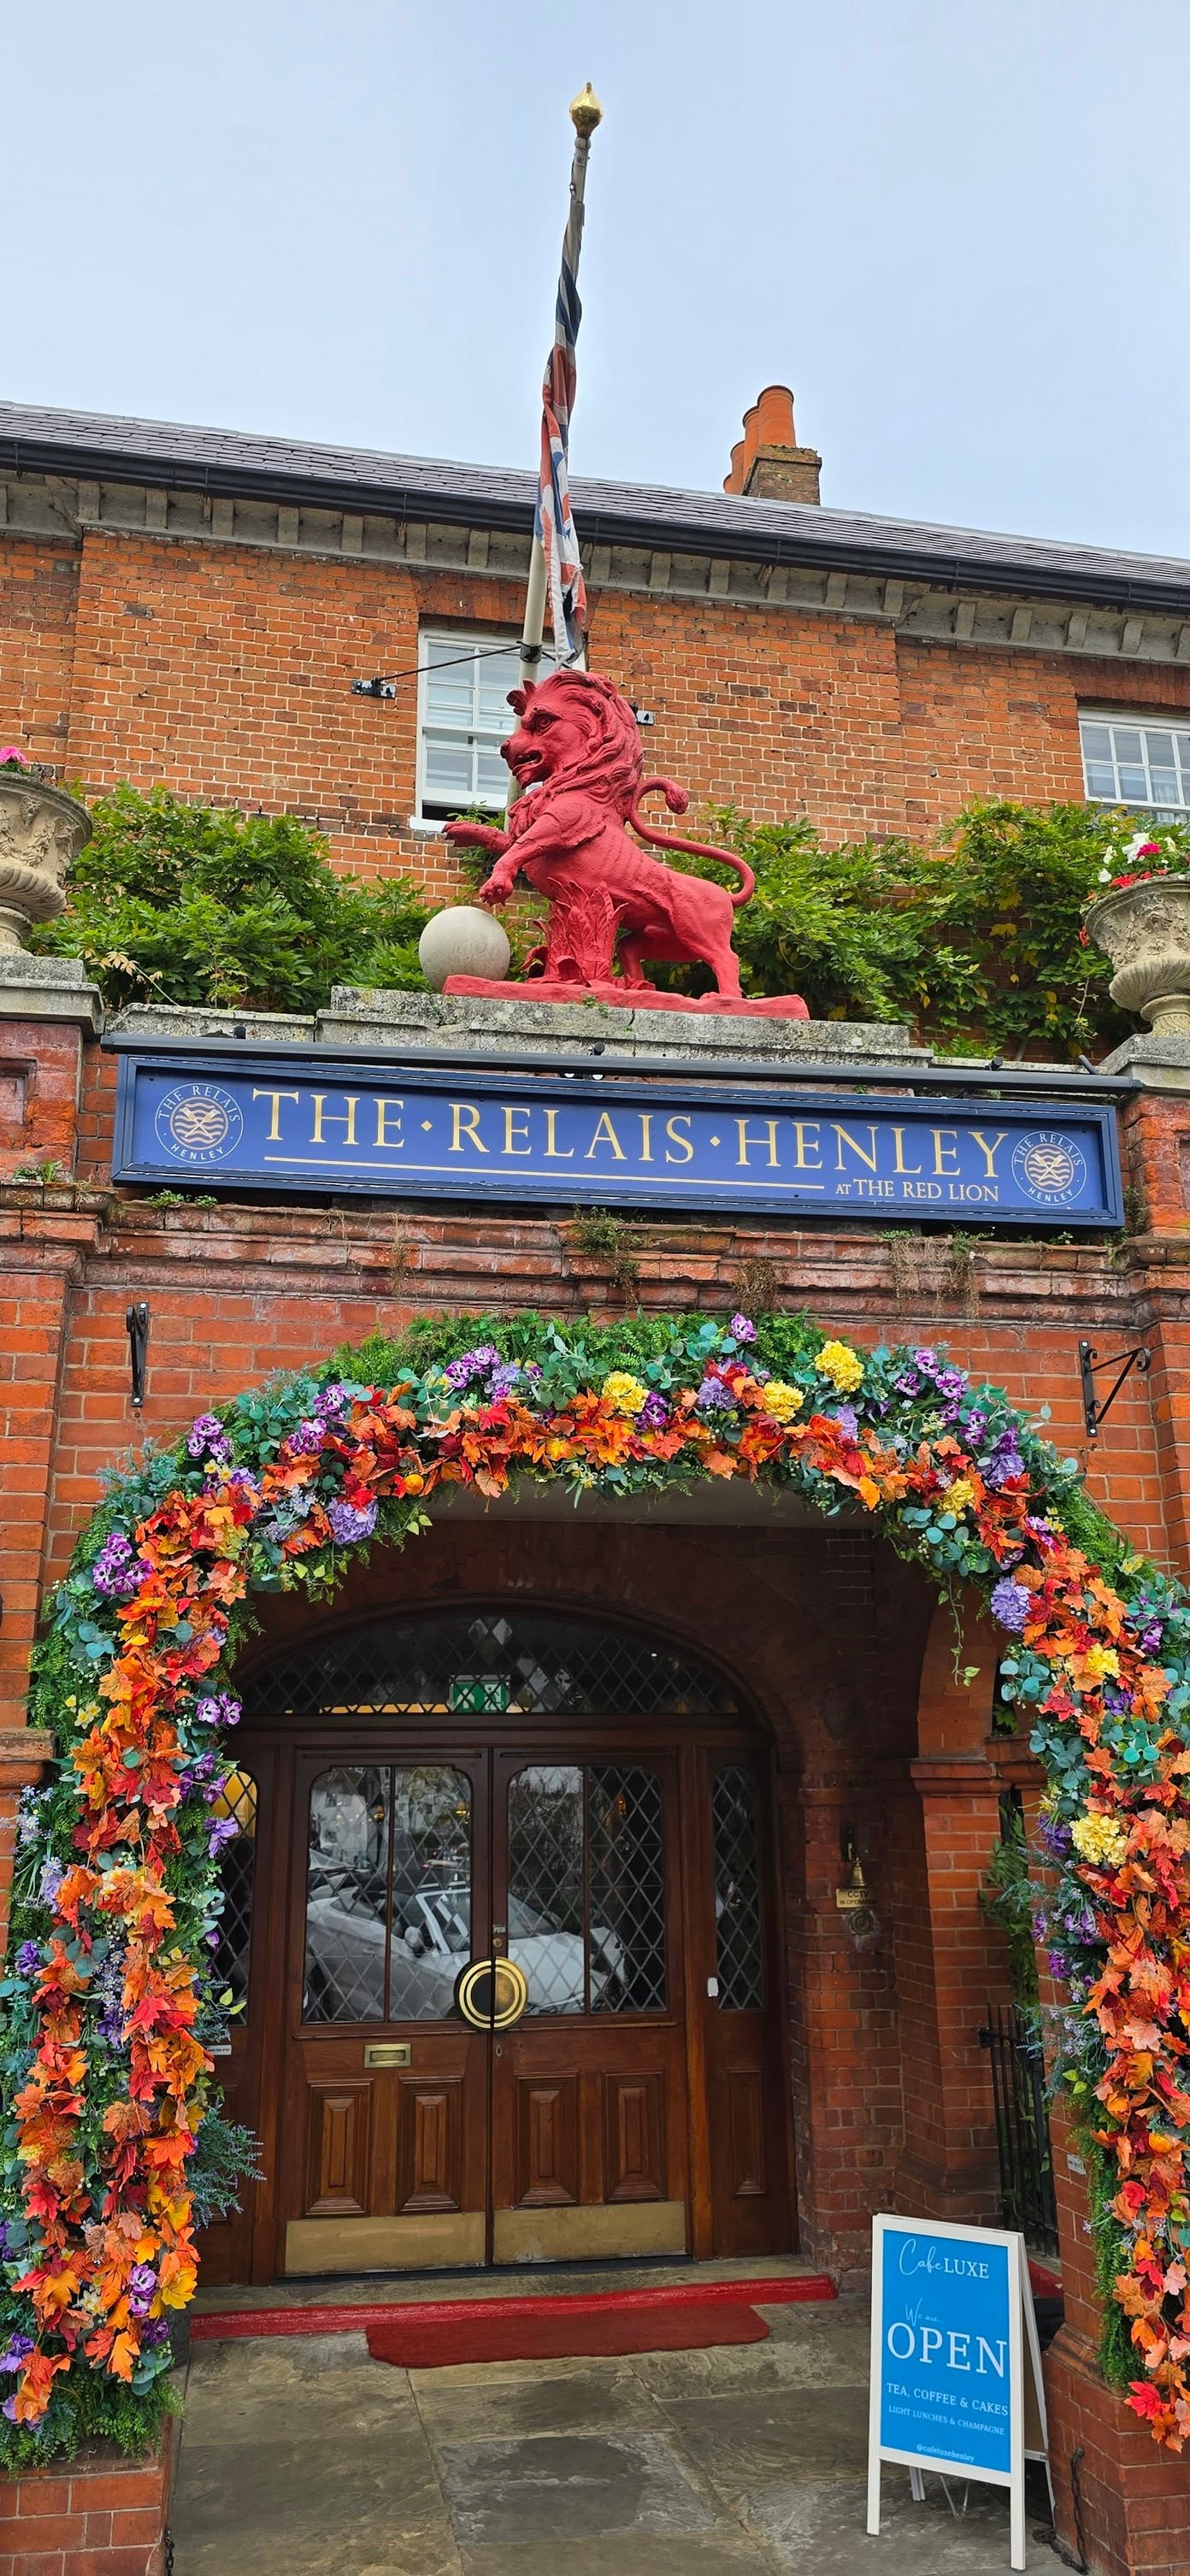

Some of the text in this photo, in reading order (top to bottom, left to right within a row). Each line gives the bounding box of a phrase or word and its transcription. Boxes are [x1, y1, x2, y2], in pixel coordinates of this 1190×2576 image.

[157, 1085, 240, 1122] THE RELAIS
[252, 1088, 1009, 1178] THE RELAIS HENLEY
[1013, 1133, 1083, 1166] THE RELAIS
[171, 1143, 224, 1160] HENLEY
[835, 1178, 999, 1203] AT THE RED LION
[1028, 1187, 1073, 1202] HENLEY
[899, 2238, 990, 2279] Cafe LUXE
[905, 2297, 924, 2327] We
[887, 2322, 1007, 2379] OPEN
[887, 2383, 1009, 2416] TEA, COFFEE & CAKES
[888, 2405, 911, 2417] LIGHT
[912, 2410, 948, 2425] LUNCHES
[957, 2419, 1005, 2436] CHAMPAGNE
